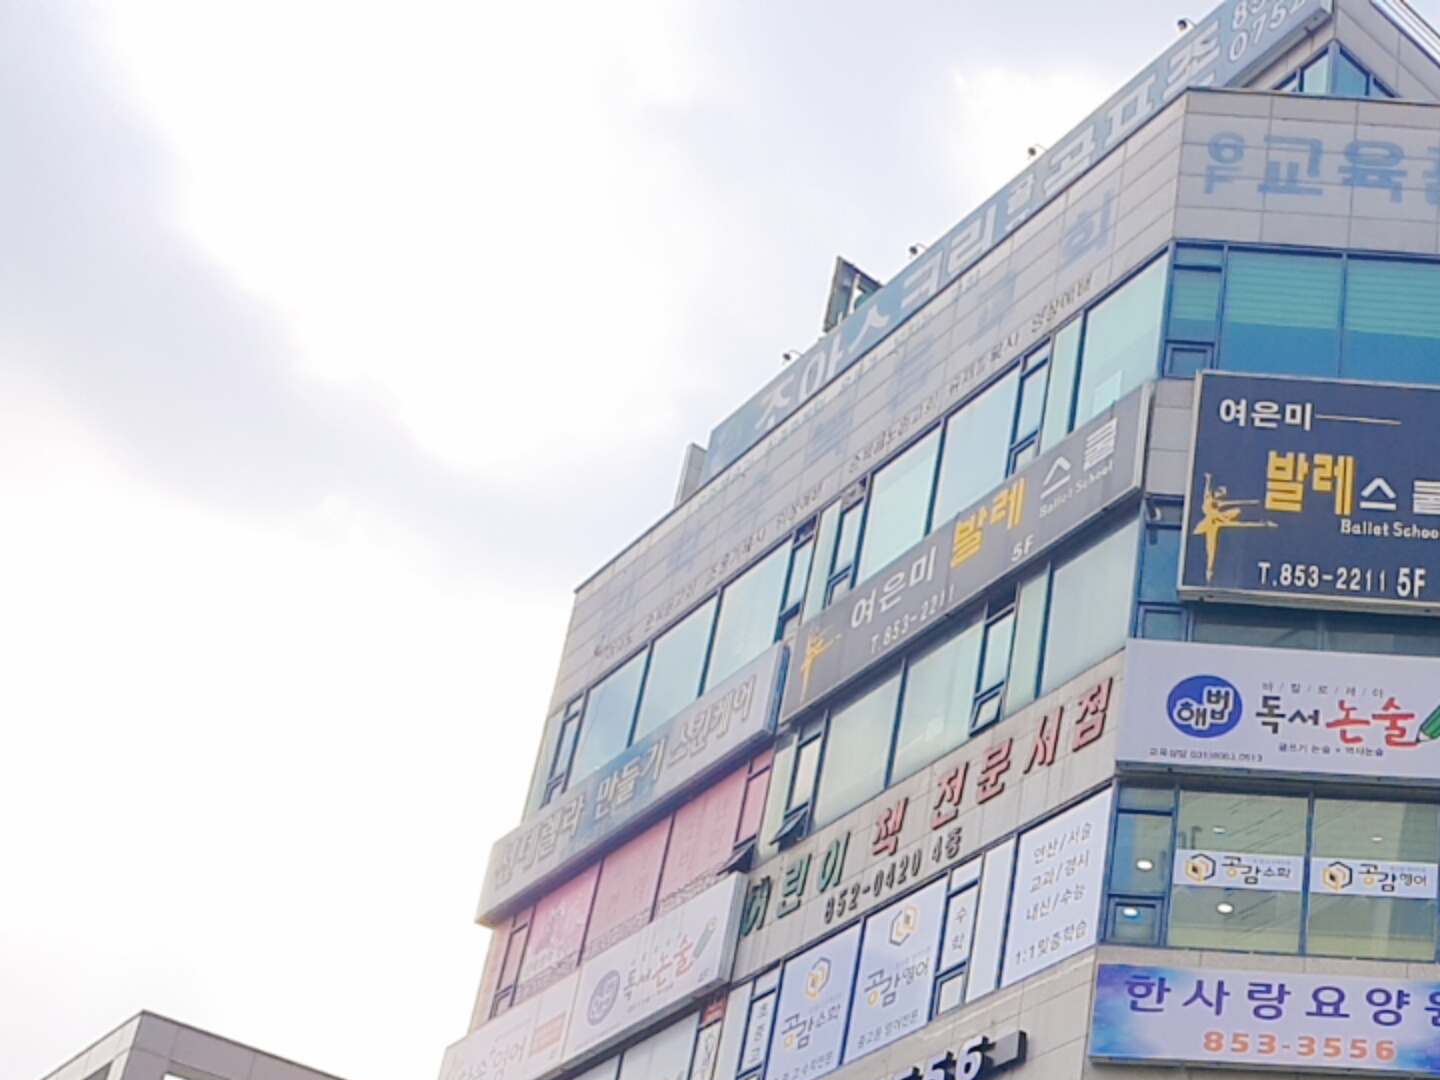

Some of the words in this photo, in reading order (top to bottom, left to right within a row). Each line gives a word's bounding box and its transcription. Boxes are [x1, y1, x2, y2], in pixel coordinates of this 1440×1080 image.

[1219, 397, 1313, 432] 여은미
[1340, 518, 1390, 539] Ballet
[1010, 535, 1036, 563] 5F
[851, 546, 937, 628] 여은미
[1396, 566, 1428, 599] 5F
[1175, 685, 1234, 729] 해법
[1221, 855, 1293, 885] 공감수학
[1357, 862, 1428, 893] 공감영어
[1202, 1029, 1397, 1062] 853-3556
